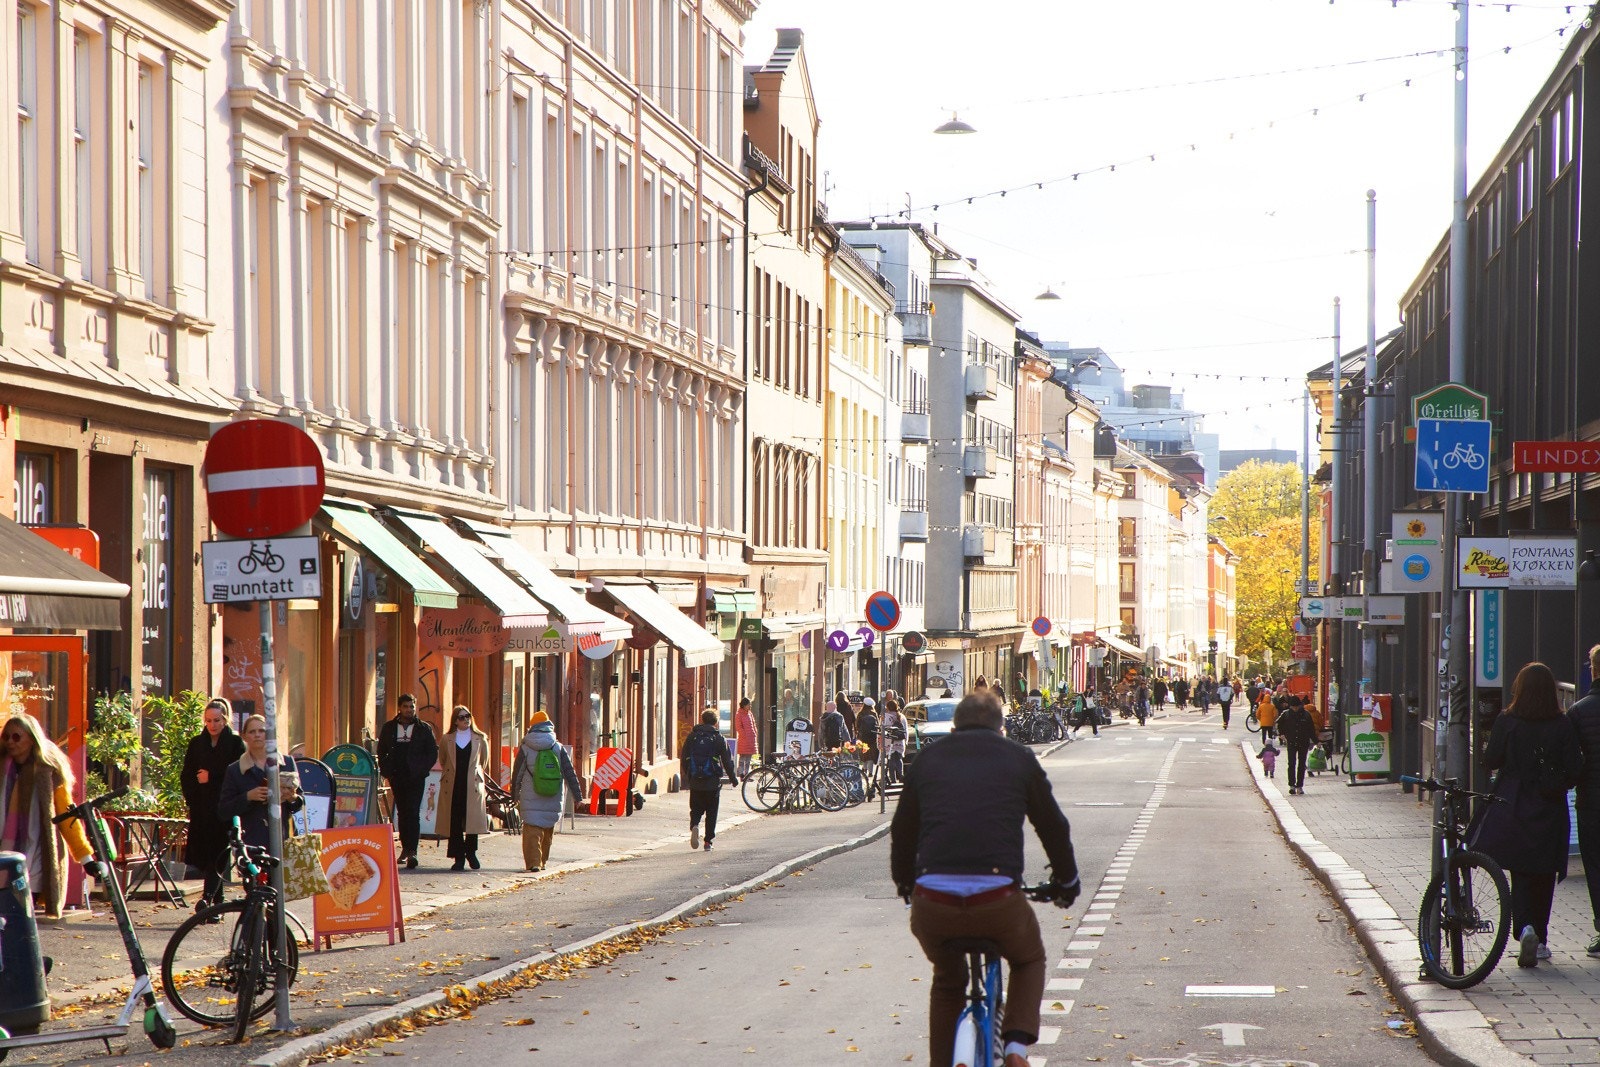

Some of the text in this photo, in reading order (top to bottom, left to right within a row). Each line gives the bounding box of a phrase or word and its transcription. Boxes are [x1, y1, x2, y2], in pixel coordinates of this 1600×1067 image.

[1470, 551, 1496, 566] Retro
[1512, 547, 1575, 559] FONTANAS
[1512, 560, 1575, 573] KJØKKEN
[231, 578, 294, 596] unntatt
[427, 617, 501, 637] Manillusion
[508, 635, 566, 650] sunkost
[579, 633, 614, 651] BRU
[363, 839, 382, 851] DIGG
